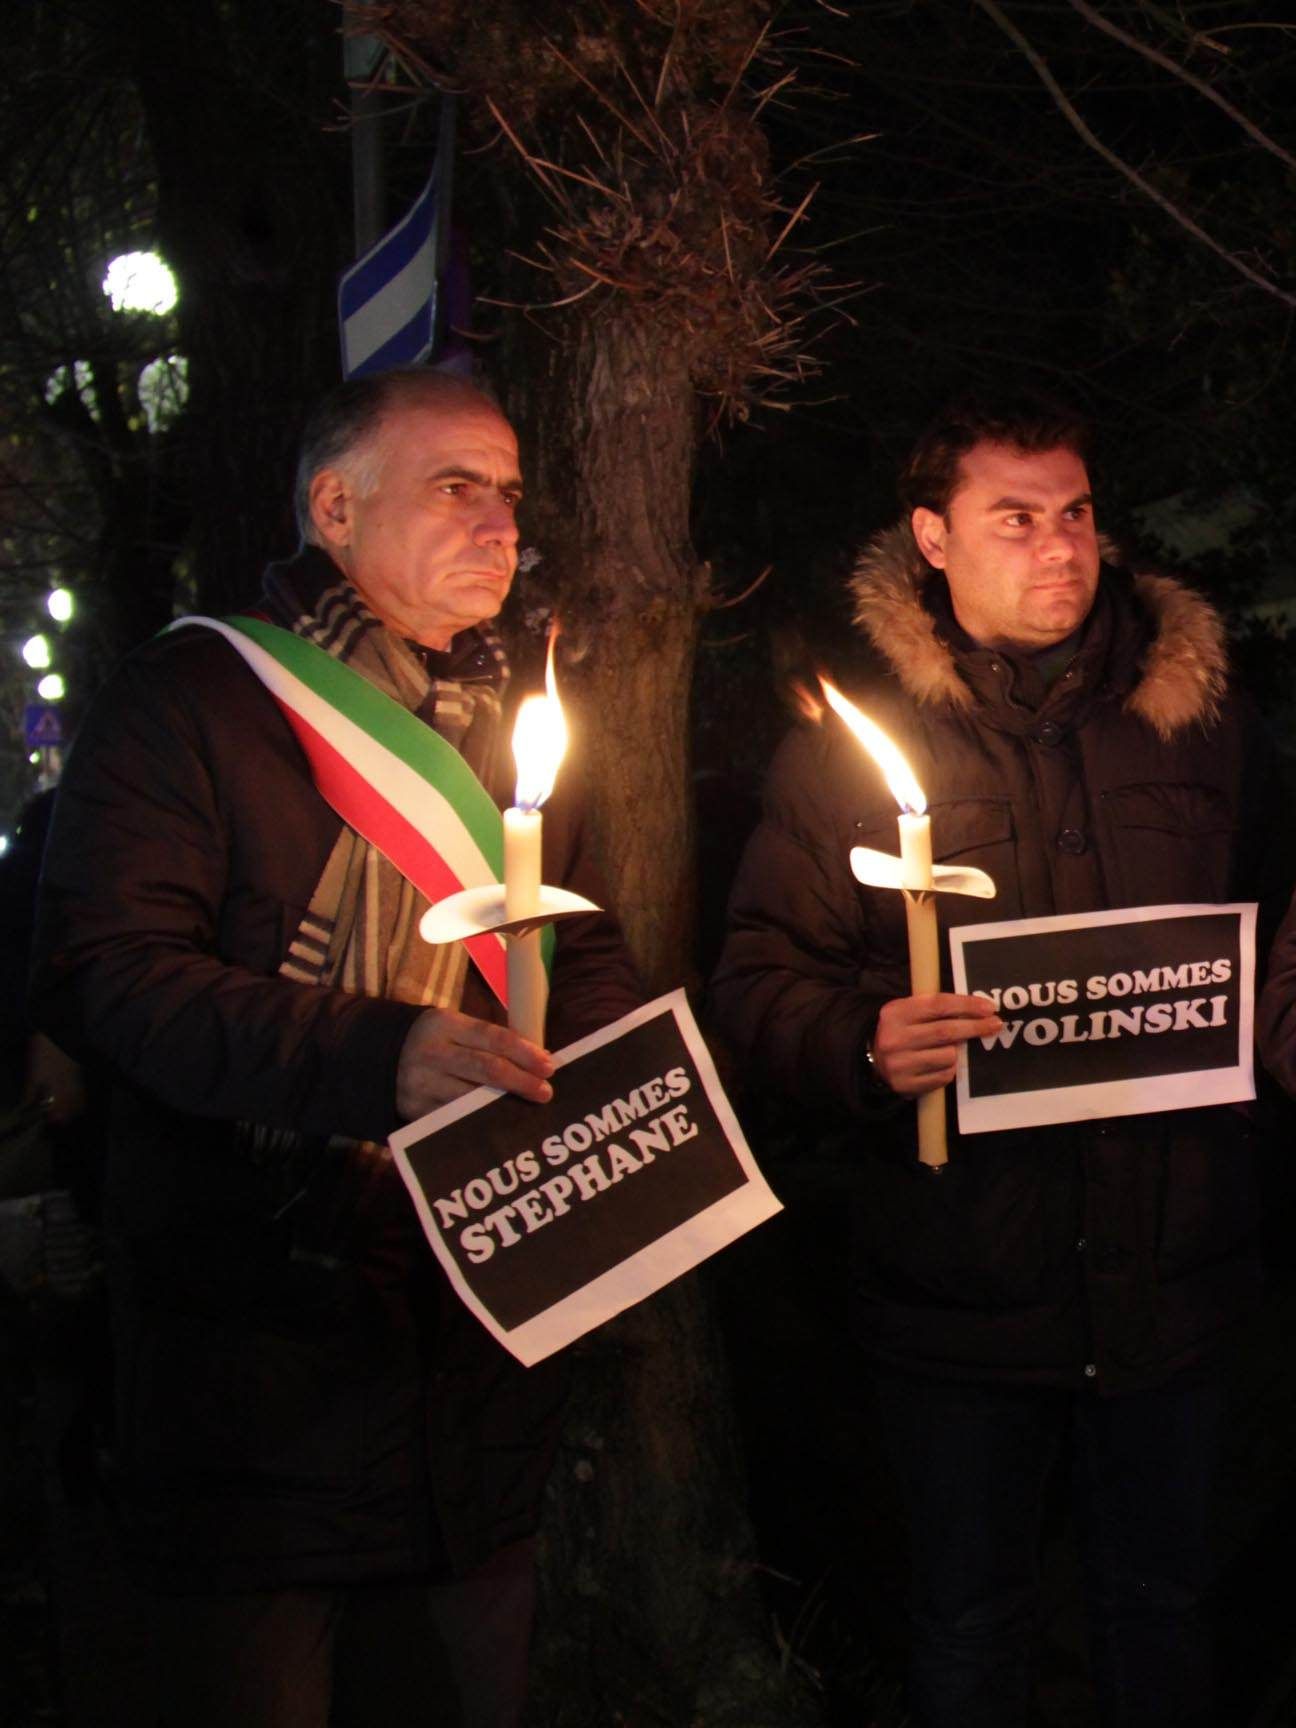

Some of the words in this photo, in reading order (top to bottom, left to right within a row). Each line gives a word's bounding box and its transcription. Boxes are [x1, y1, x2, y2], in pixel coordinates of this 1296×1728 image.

[972, 979, 1079, 1012] NOUS
[1086, 959, 1232, 1000] SOMMES
[980, 995, 1229, 1051] WOLINSKI
[432, 1150, 541, 1229] NOUS
[541, 1066, 691, 1166] SOMMES
[460, 1104, 699, 1264] STEPHANE
